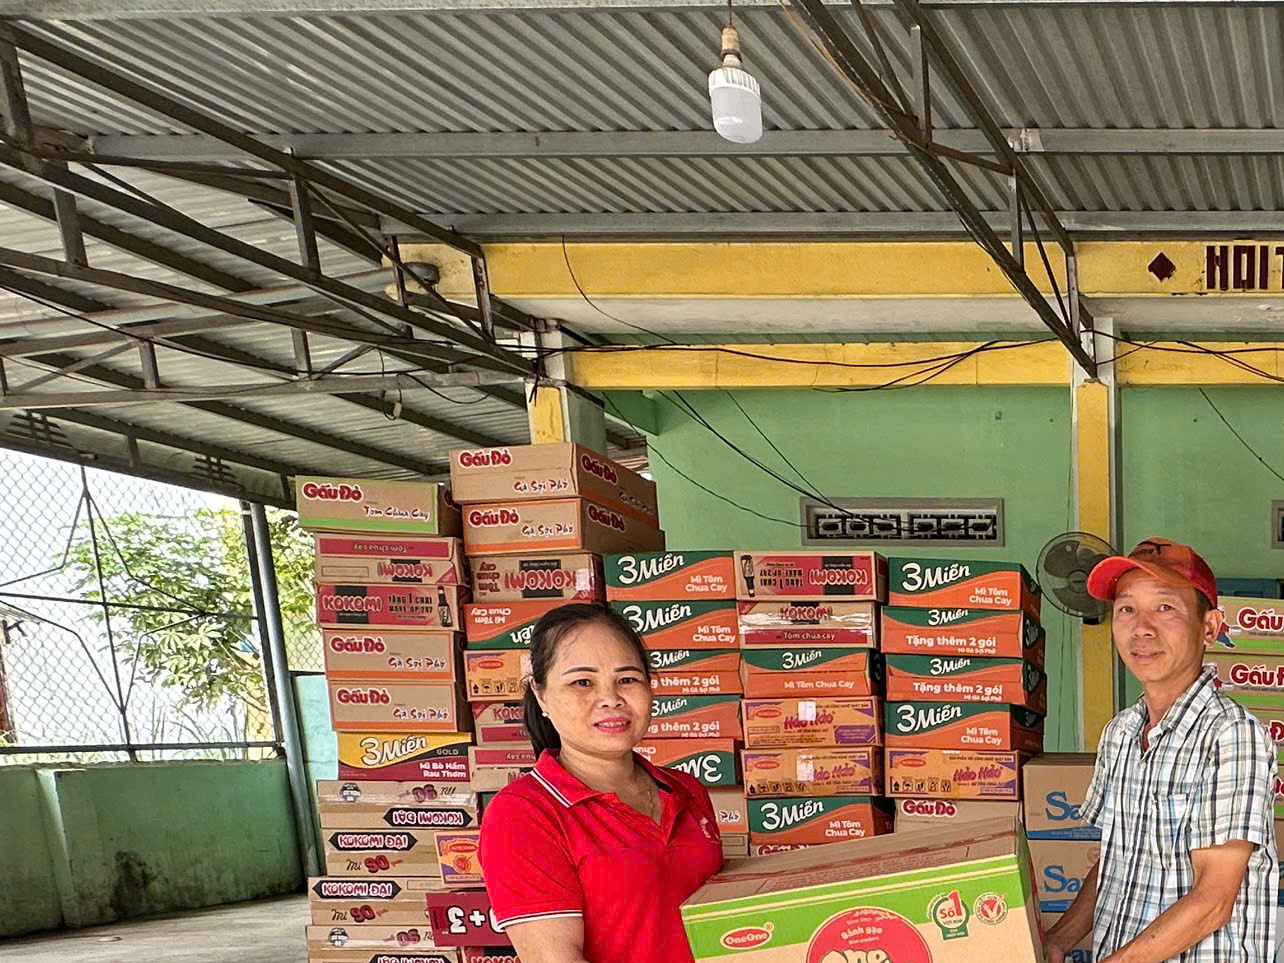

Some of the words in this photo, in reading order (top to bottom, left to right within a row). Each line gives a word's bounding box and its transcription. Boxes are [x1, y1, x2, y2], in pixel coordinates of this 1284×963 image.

[322, 595, 383, 612] KOKOMI
[1238, 607, 1283, 631] Gấu
[969, 637, 977, 646] 2
[979, 636, 996, 649] gói
[693, 677, 700, 686] 2
[702, 675, 719, 688] gói
[976, 684, 983, 693] 2
[985, 684, 1002, 696] gói
[693, 722, 700, 731] 2
[702, 721, 719, 733] gói
[338, 834, 384, 848] KOKOMI
[322, 882, 368, 896] KOKOMI
